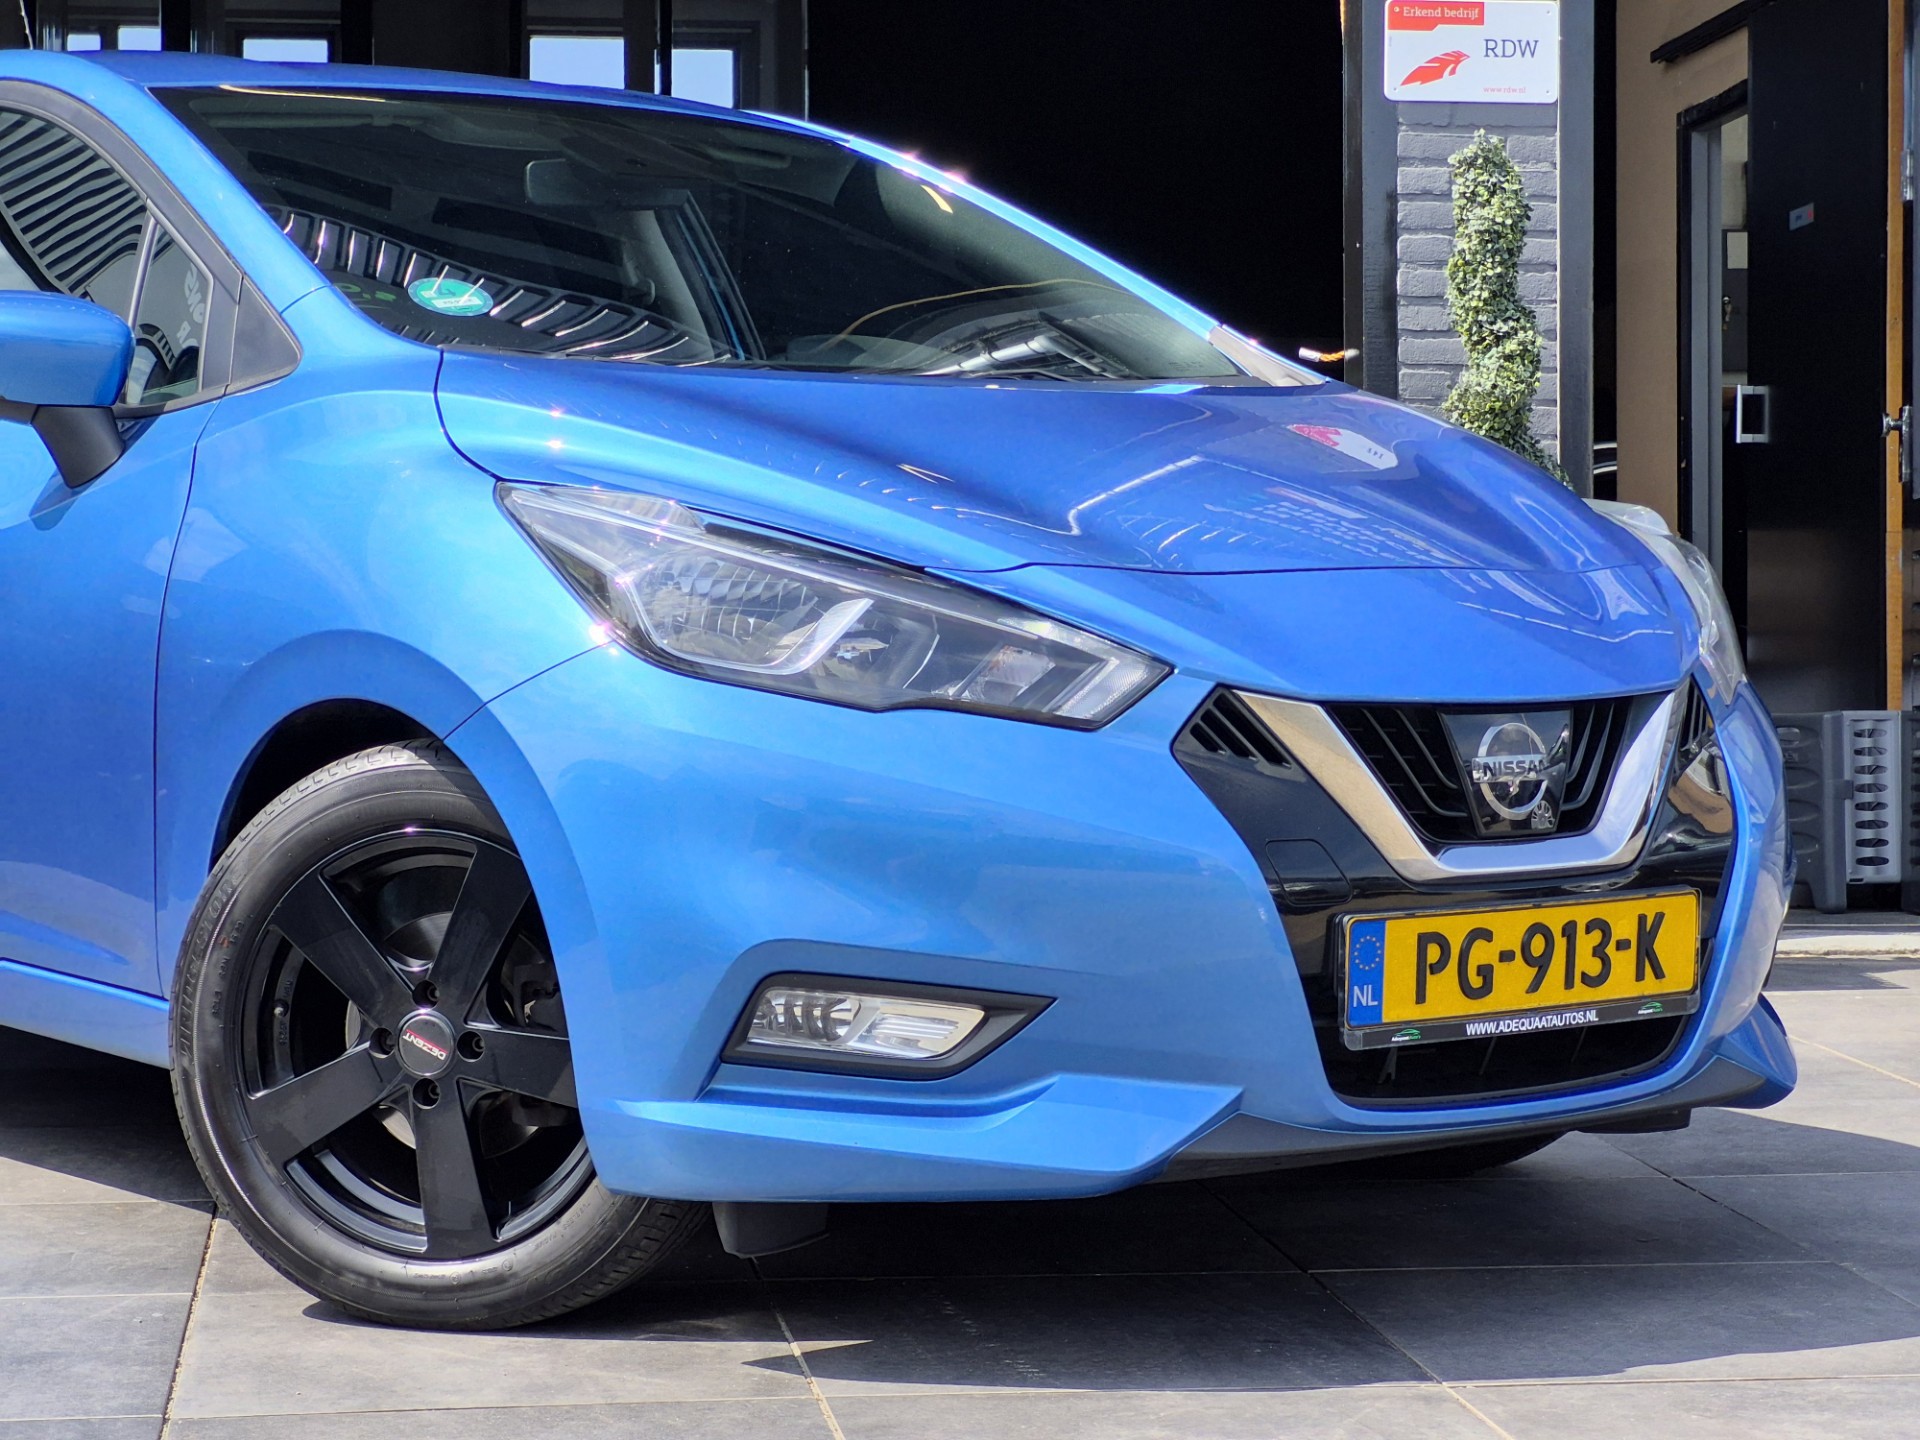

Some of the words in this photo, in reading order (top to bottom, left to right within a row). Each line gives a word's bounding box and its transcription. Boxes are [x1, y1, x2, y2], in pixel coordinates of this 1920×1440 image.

[1403, 6, 1441, 17] Erkend
[1444, 7, 1479, 20] bedrijf
[1483, 38, 1540, 59] RDW
[1415, 911, 1666, 1005] PG-913-K
[1353, 984, 1378, 1008] NL
[1466, 1009, 1599, 1036] WWW.ADEQUAATAUTOS.NL
[402, 1032, 447, 1061] DEZENT
